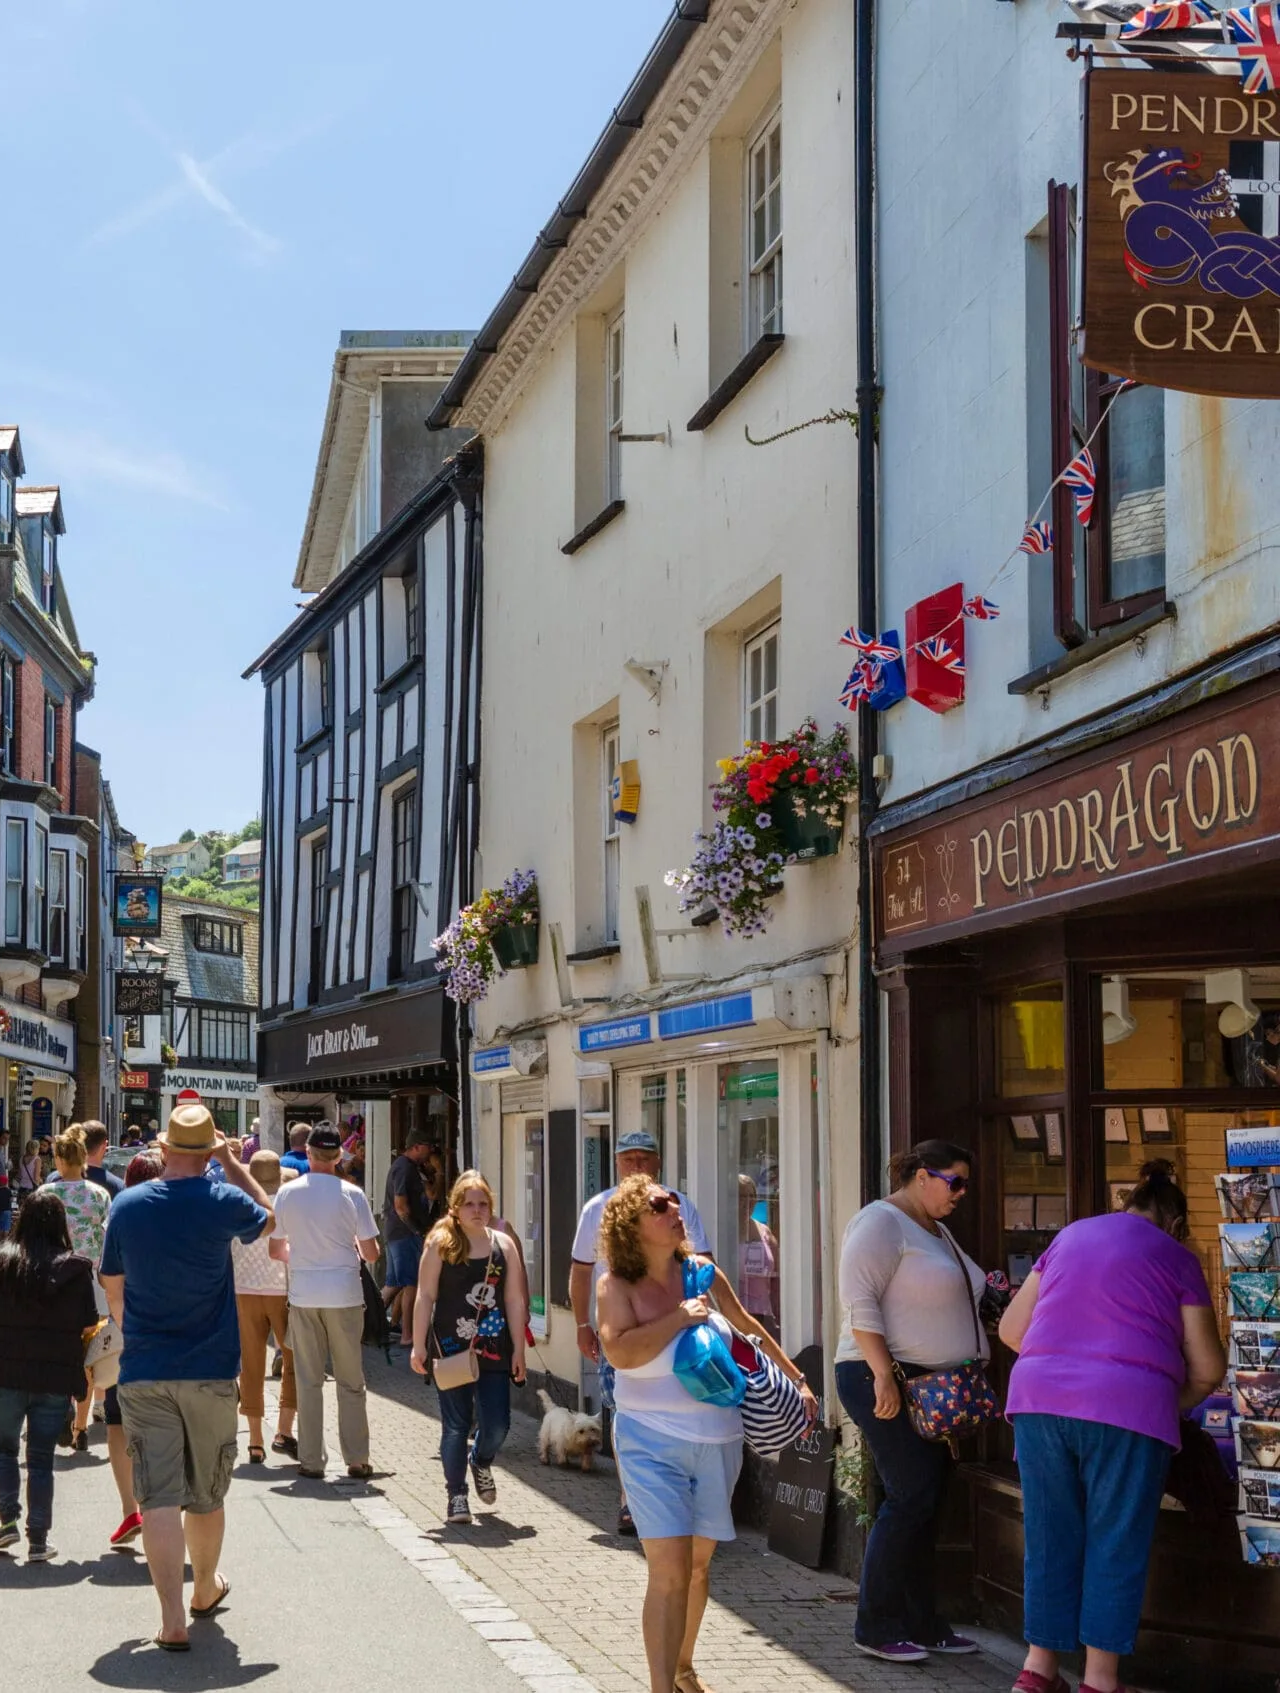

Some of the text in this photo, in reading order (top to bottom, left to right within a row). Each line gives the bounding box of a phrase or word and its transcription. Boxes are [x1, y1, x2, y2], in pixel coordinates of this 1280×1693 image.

[1134, 303, 1280, 354] CRA
[121, 978, 157, 987] ROOMS
[343, 1028, 350, 1052] &
[126, 1074, 145, 1085] SE
[167, 1075, 222, 1090] MOUNTAIN
[804, 1487, 826, 1514] CARDS
